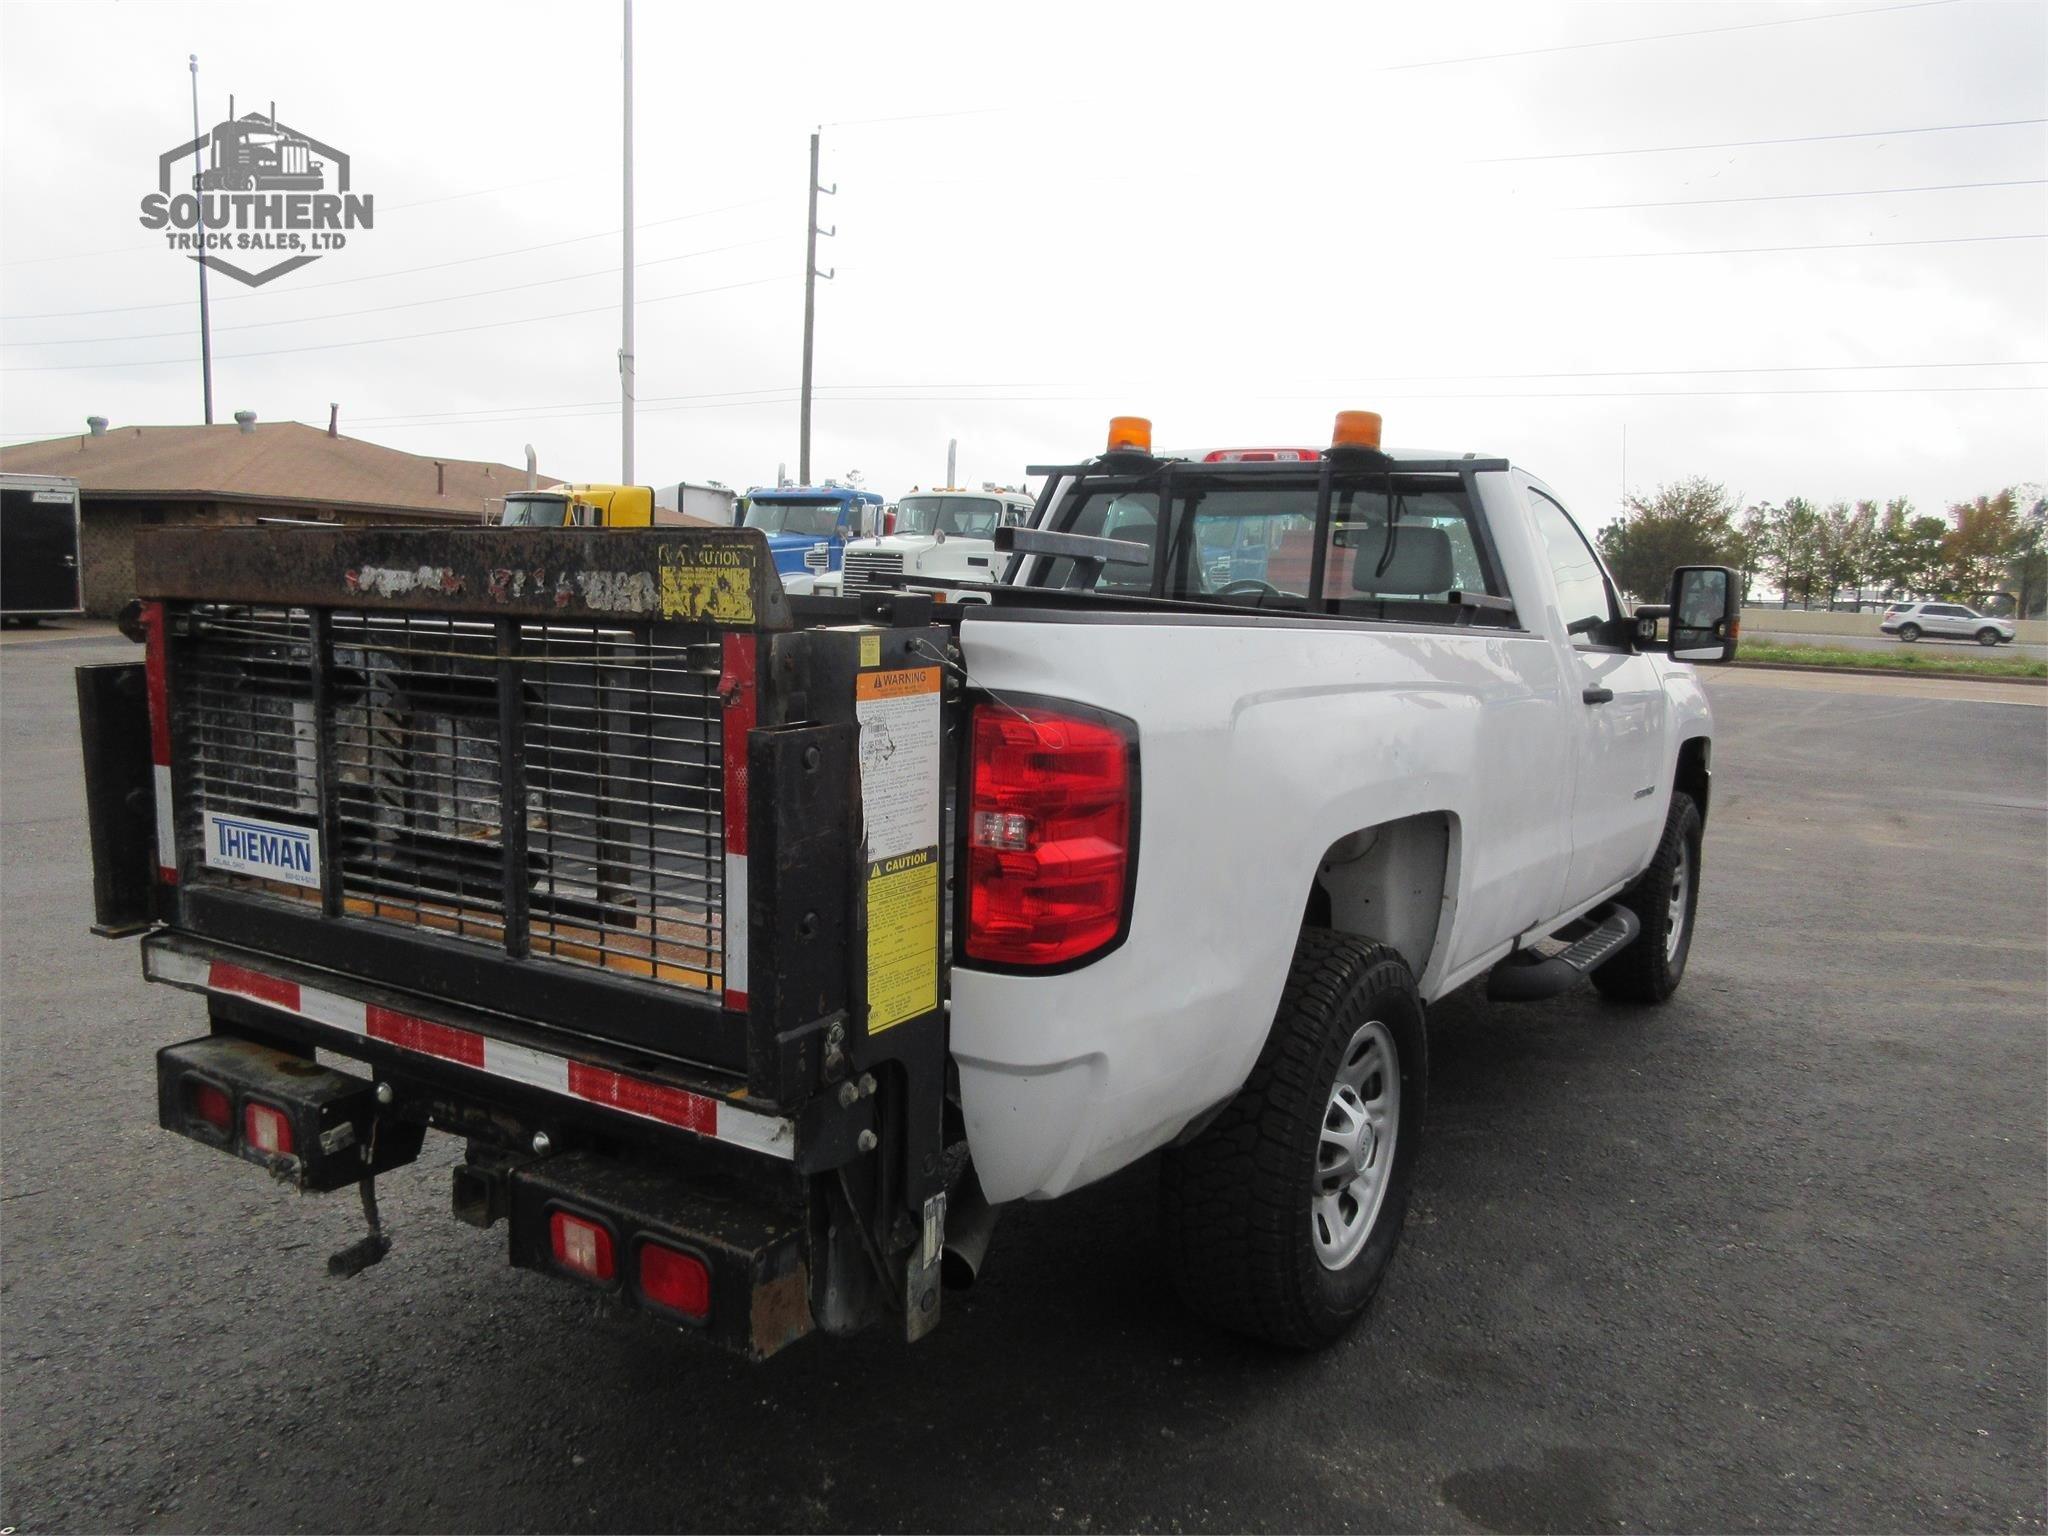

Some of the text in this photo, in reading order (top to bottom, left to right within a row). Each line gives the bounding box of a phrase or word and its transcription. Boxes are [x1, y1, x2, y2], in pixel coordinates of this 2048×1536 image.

[883, 671, 927, 686] WARNING
[212, 817, 311, 872] THIEMAN
[885, 852, 927, 872] CAUTION
